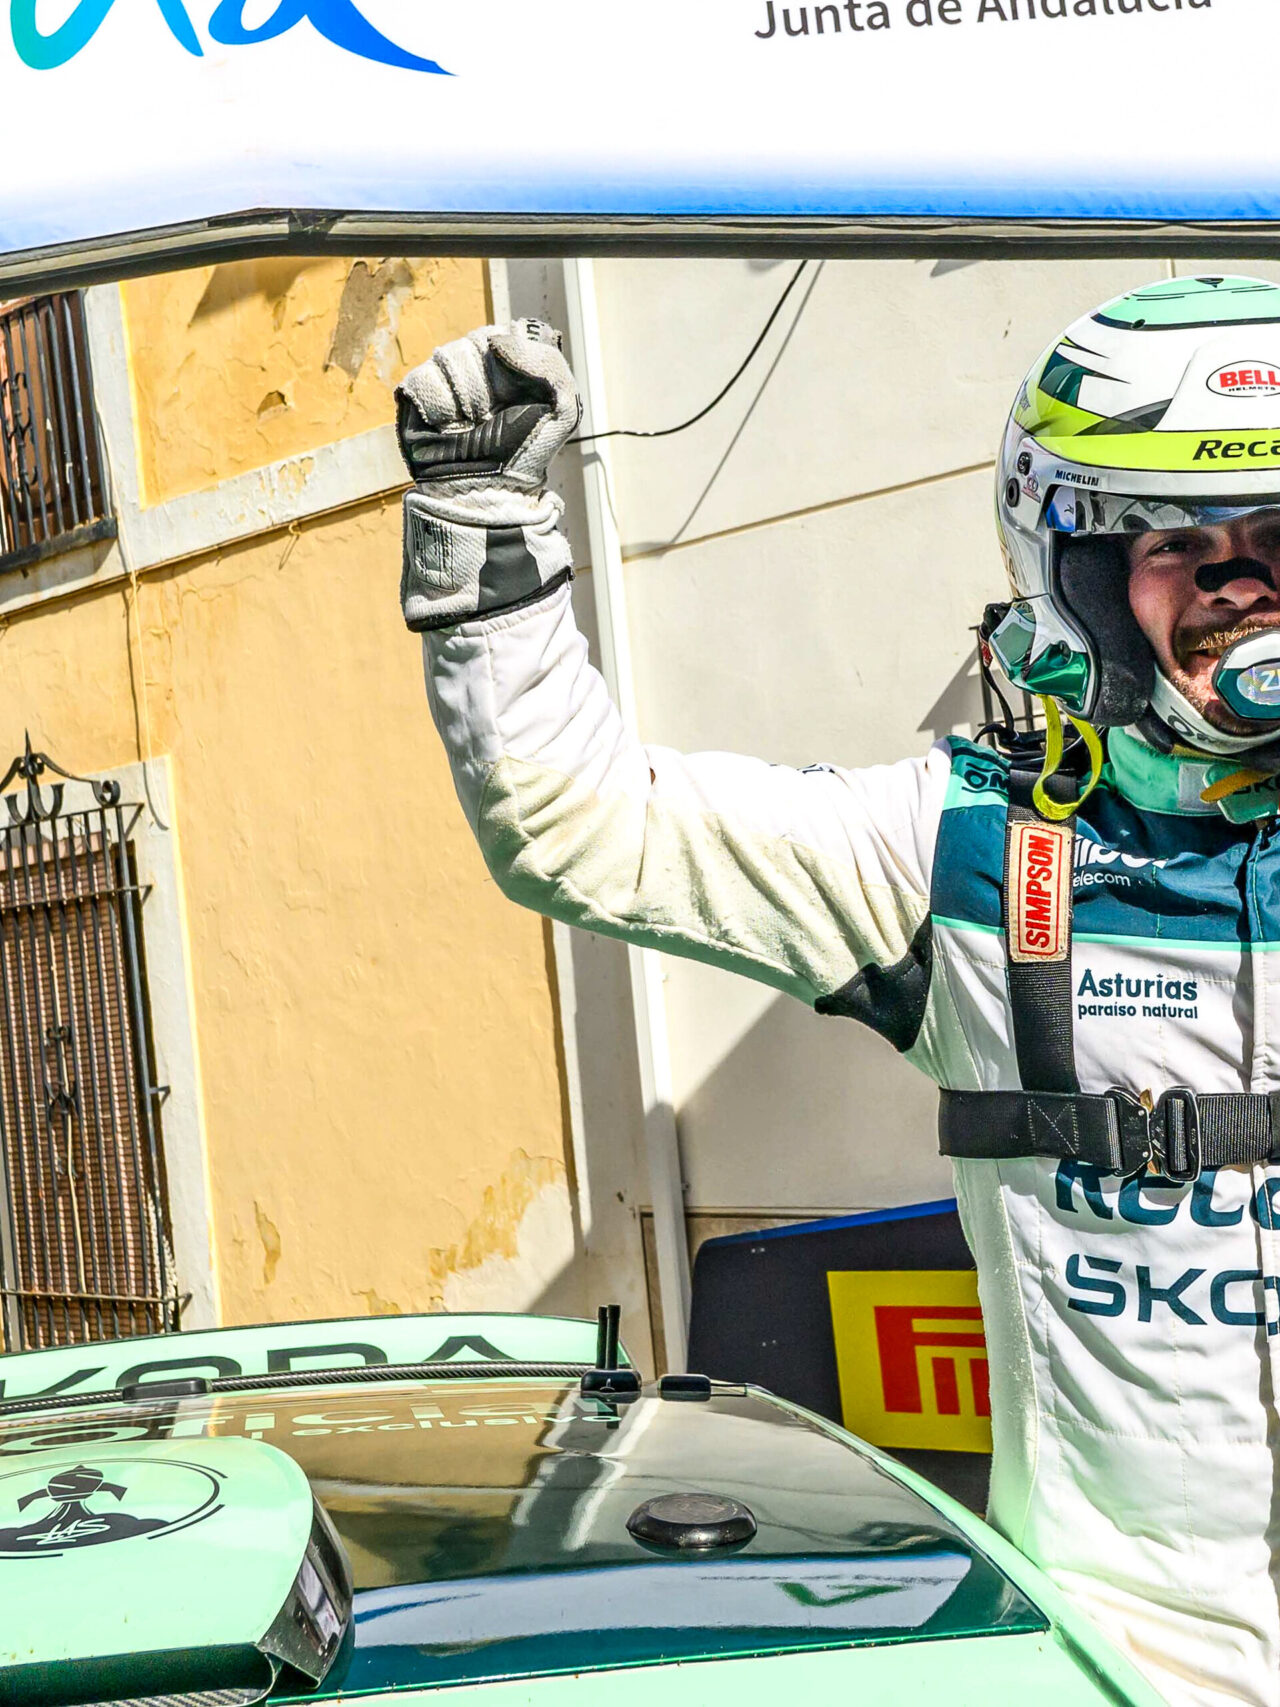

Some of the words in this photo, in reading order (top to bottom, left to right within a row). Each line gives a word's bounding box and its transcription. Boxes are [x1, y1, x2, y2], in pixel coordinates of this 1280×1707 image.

[754, 0, 891, 39] Junta
[906, 0, 962, 27] de
[1055, 469, 1100, 487] MICHELIN
[964, 769, 1009, 790] OM
[1073, 870, 1131, 887] elecom
[1025, 834, 1055, 948] SIMPSON
[1077, 968, 1198, 1001] Asturias
[1142, 1003, 1198, 1019] natural
[292, 1415, 622, 1436] exclusivo
